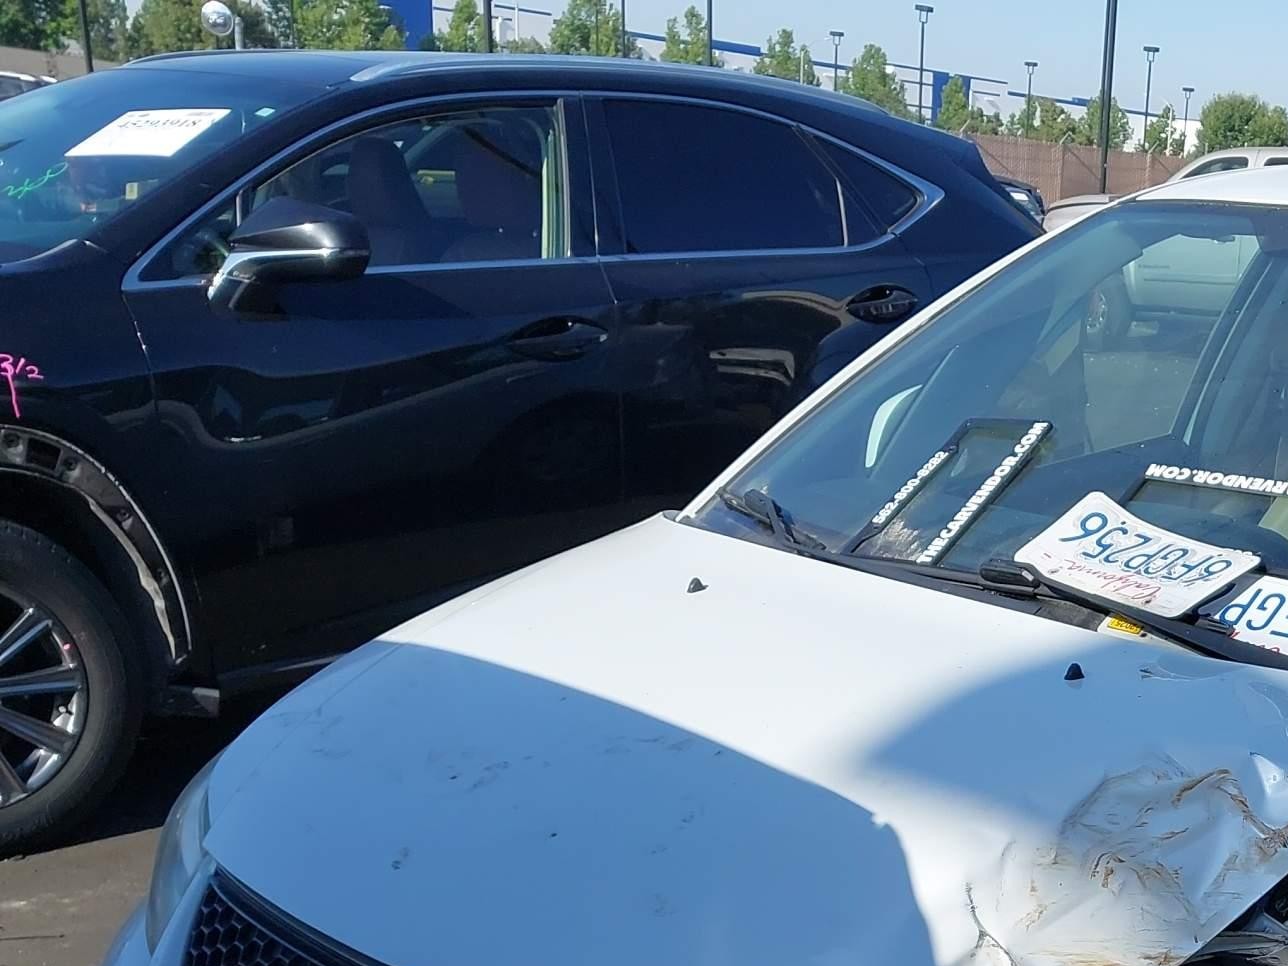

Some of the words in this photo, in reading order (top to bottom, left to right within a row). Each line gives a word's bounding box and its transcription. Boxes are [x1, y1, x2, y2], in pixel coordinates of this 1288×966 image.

[916, 422, 1049, 564] THECARVENDOR.COM
[1058, 511, 1233, 587] 6FGP256
[1064, 558, 1163, 600] California
